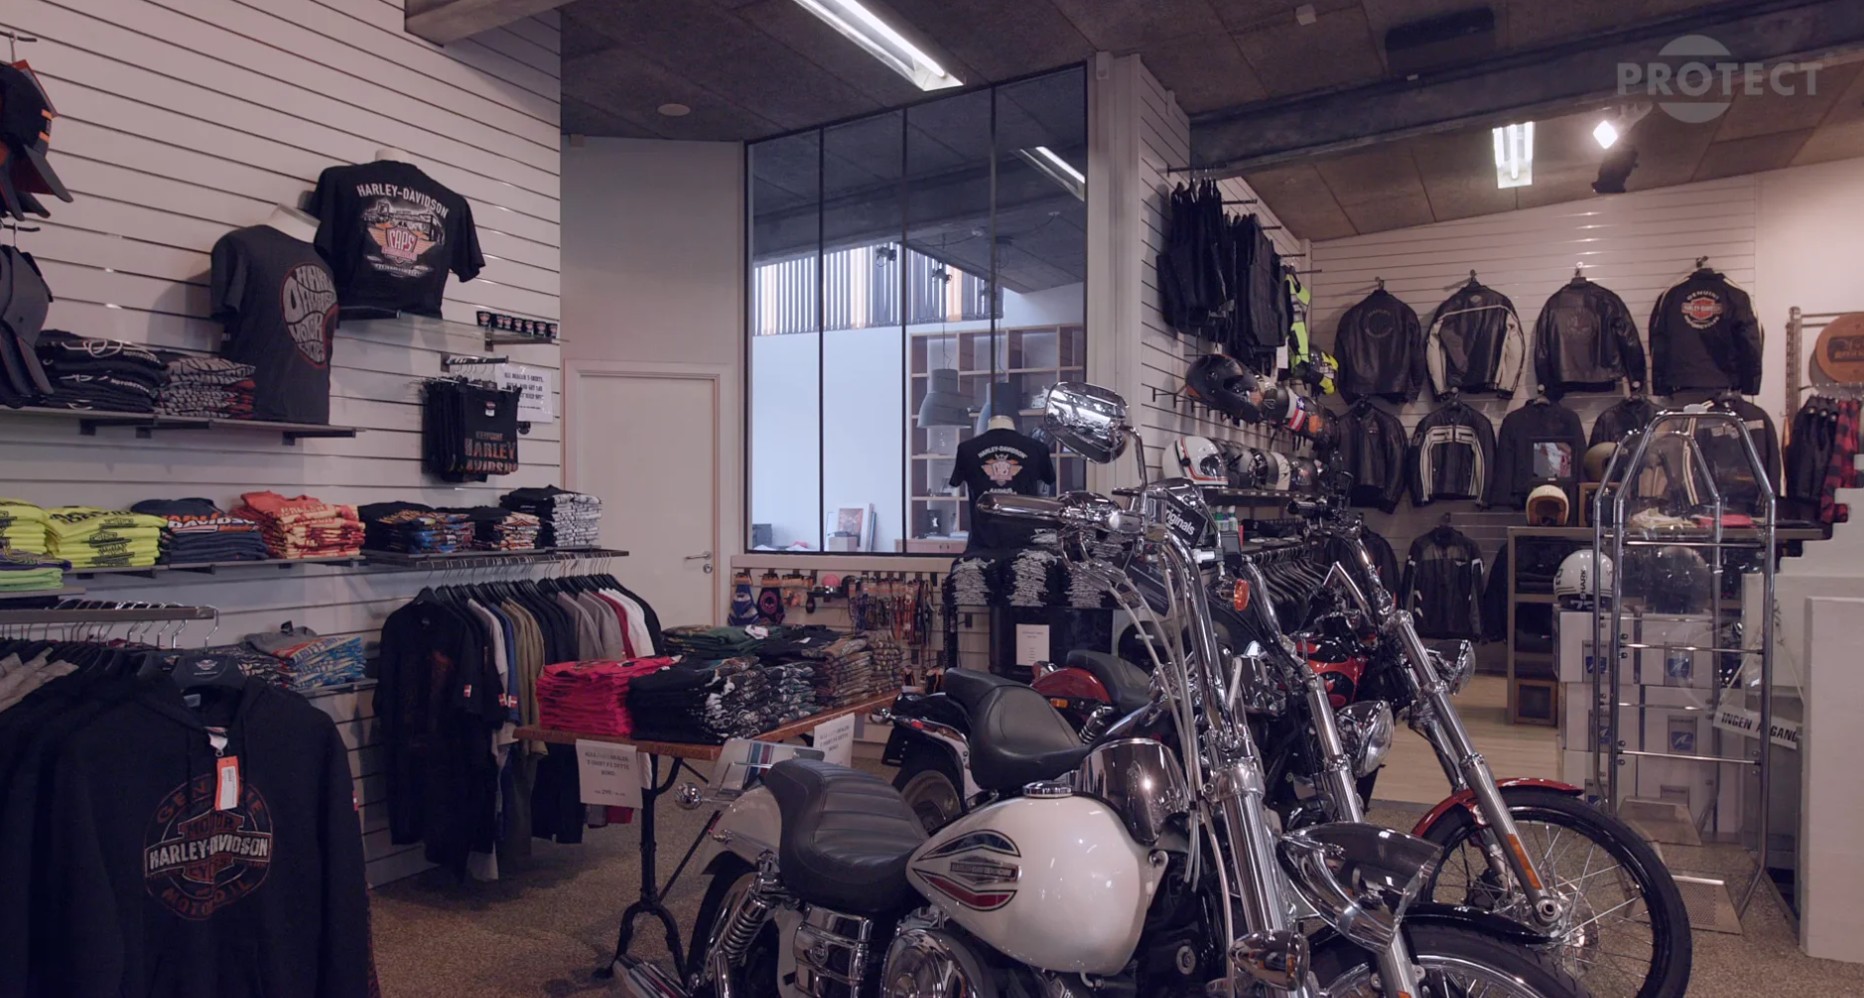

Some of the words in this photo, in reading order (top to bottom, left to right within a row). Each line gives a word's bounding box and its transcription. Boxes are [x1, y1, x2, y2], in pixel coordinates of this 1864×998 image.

[357, 183, 449, 219] HARLEY-DAVIDSON
[389, 229, 414, 252] CAPS
[464, 438, 516, 460] HARLEY
[1166, 508, 1195, 536] iginals
[1721, 712, 1753, 731] INGEN
[1756, 722, 1797, 742] GAN
[149, 834, 268, 870] HARLEY-DVIDSON
